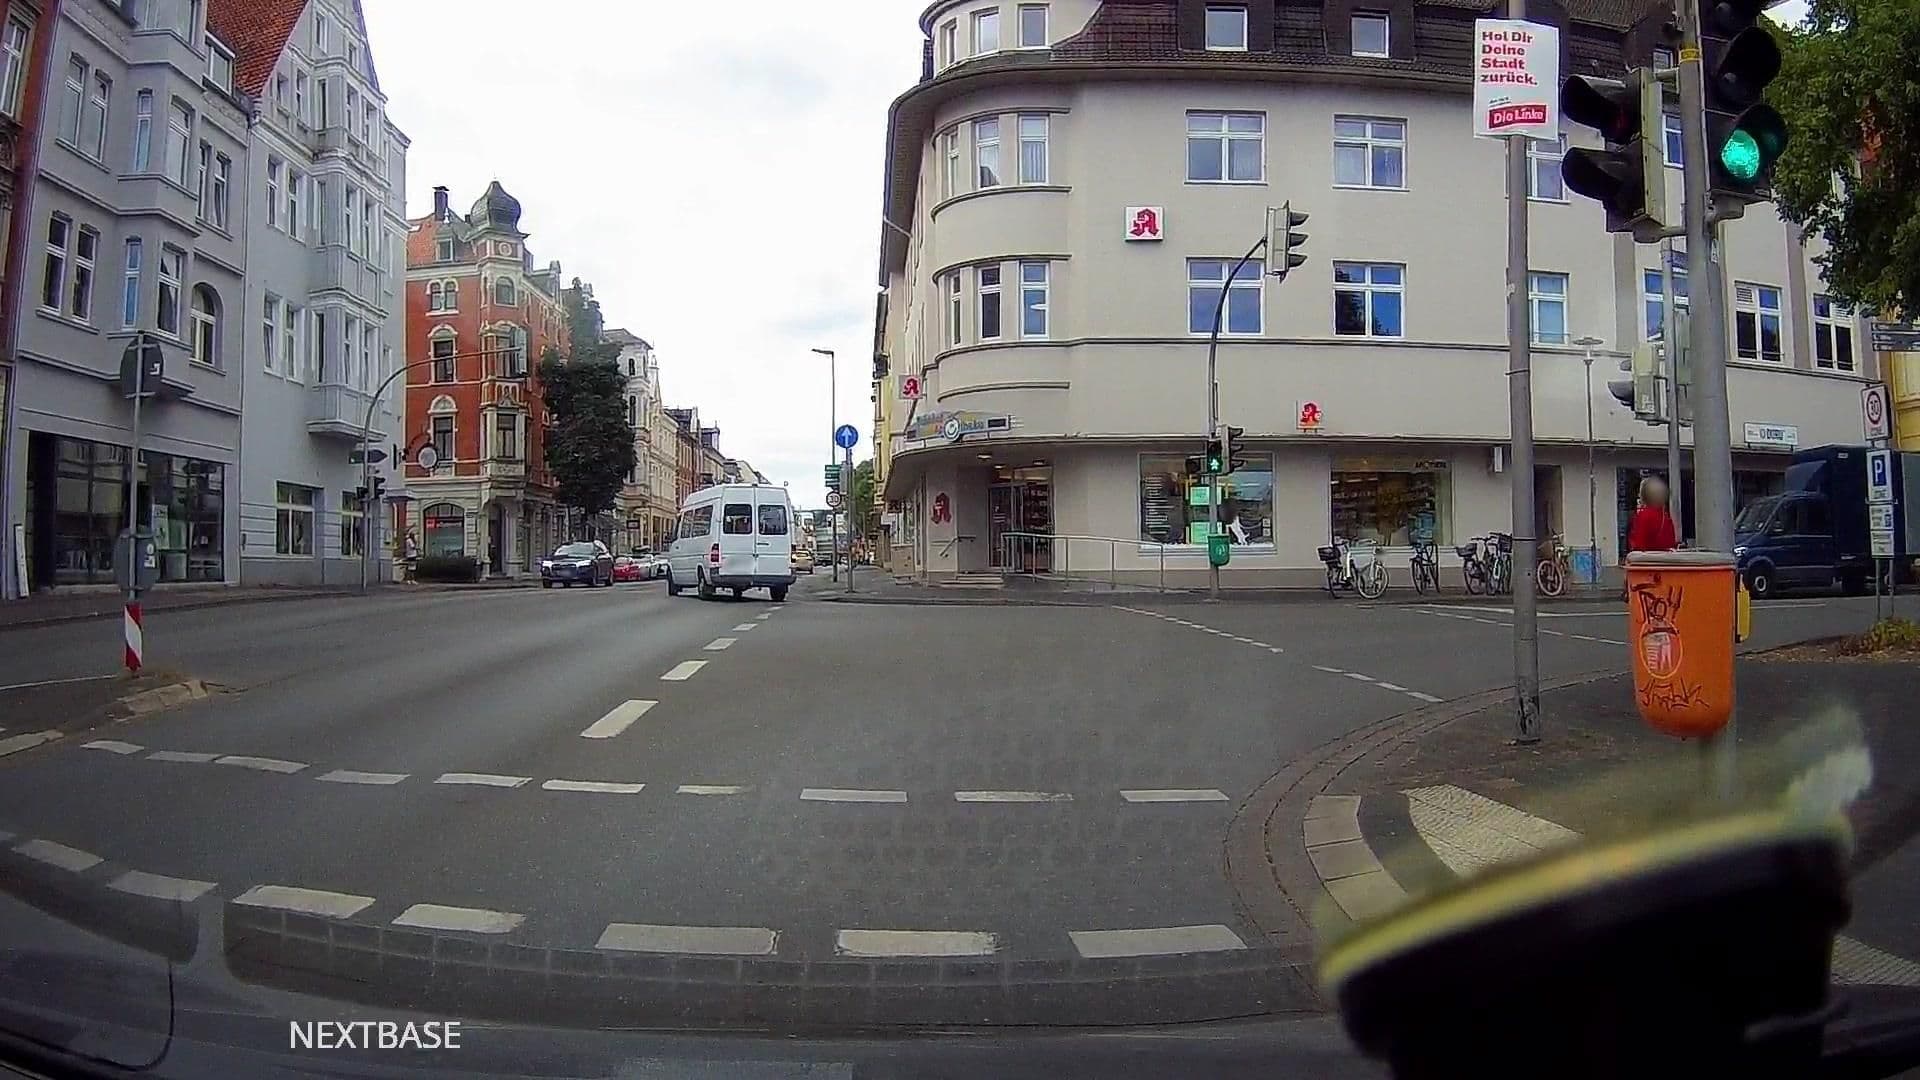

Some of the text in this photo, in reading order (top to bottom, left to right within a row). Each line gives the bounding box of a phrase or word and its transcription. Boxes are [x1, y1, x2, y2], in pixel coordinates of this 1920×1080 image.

[1482, 31, 1533, 43] Hol Dir
[1482, 44, 1525, 56] Deine
[1481, 58, 1525, 70] Stadt
[1481, 72, 1538, 86] zurück.
[1493, 108, 1544, 124] Die Linke
[1874, 459, 1883, 483] P
